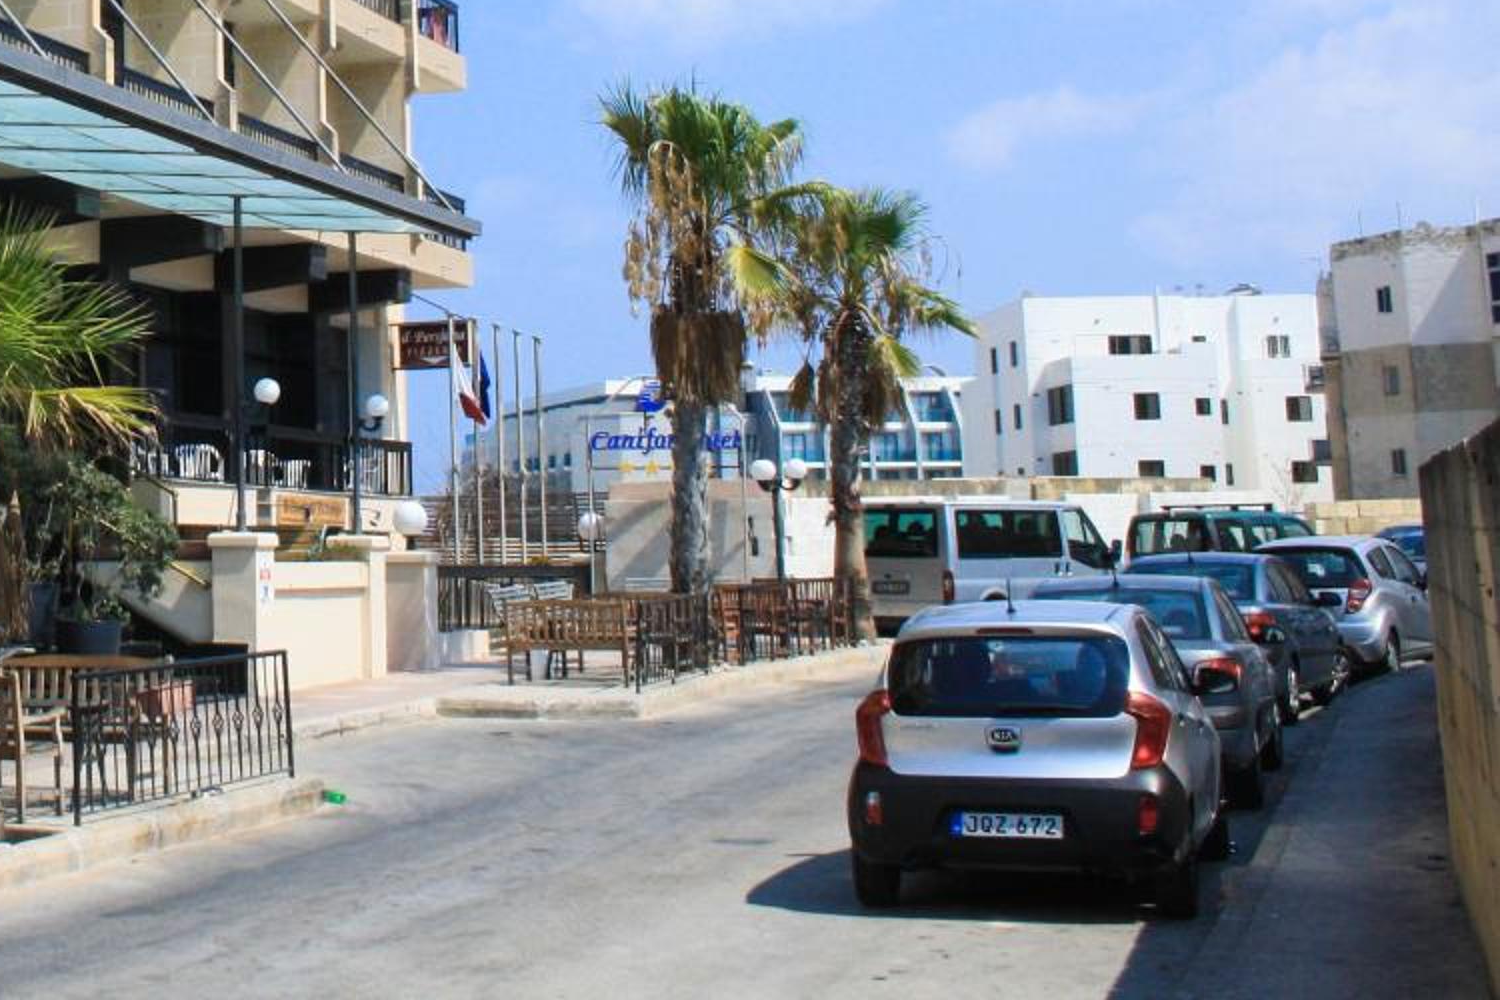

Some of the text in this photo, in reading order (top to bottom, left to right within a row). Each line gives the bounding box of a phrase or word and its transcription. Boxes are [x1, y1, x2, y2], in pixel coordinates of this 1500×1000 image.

[993, 730, 1014, 742] KIA
[965, 815, 1057, 836] JQZ 672
